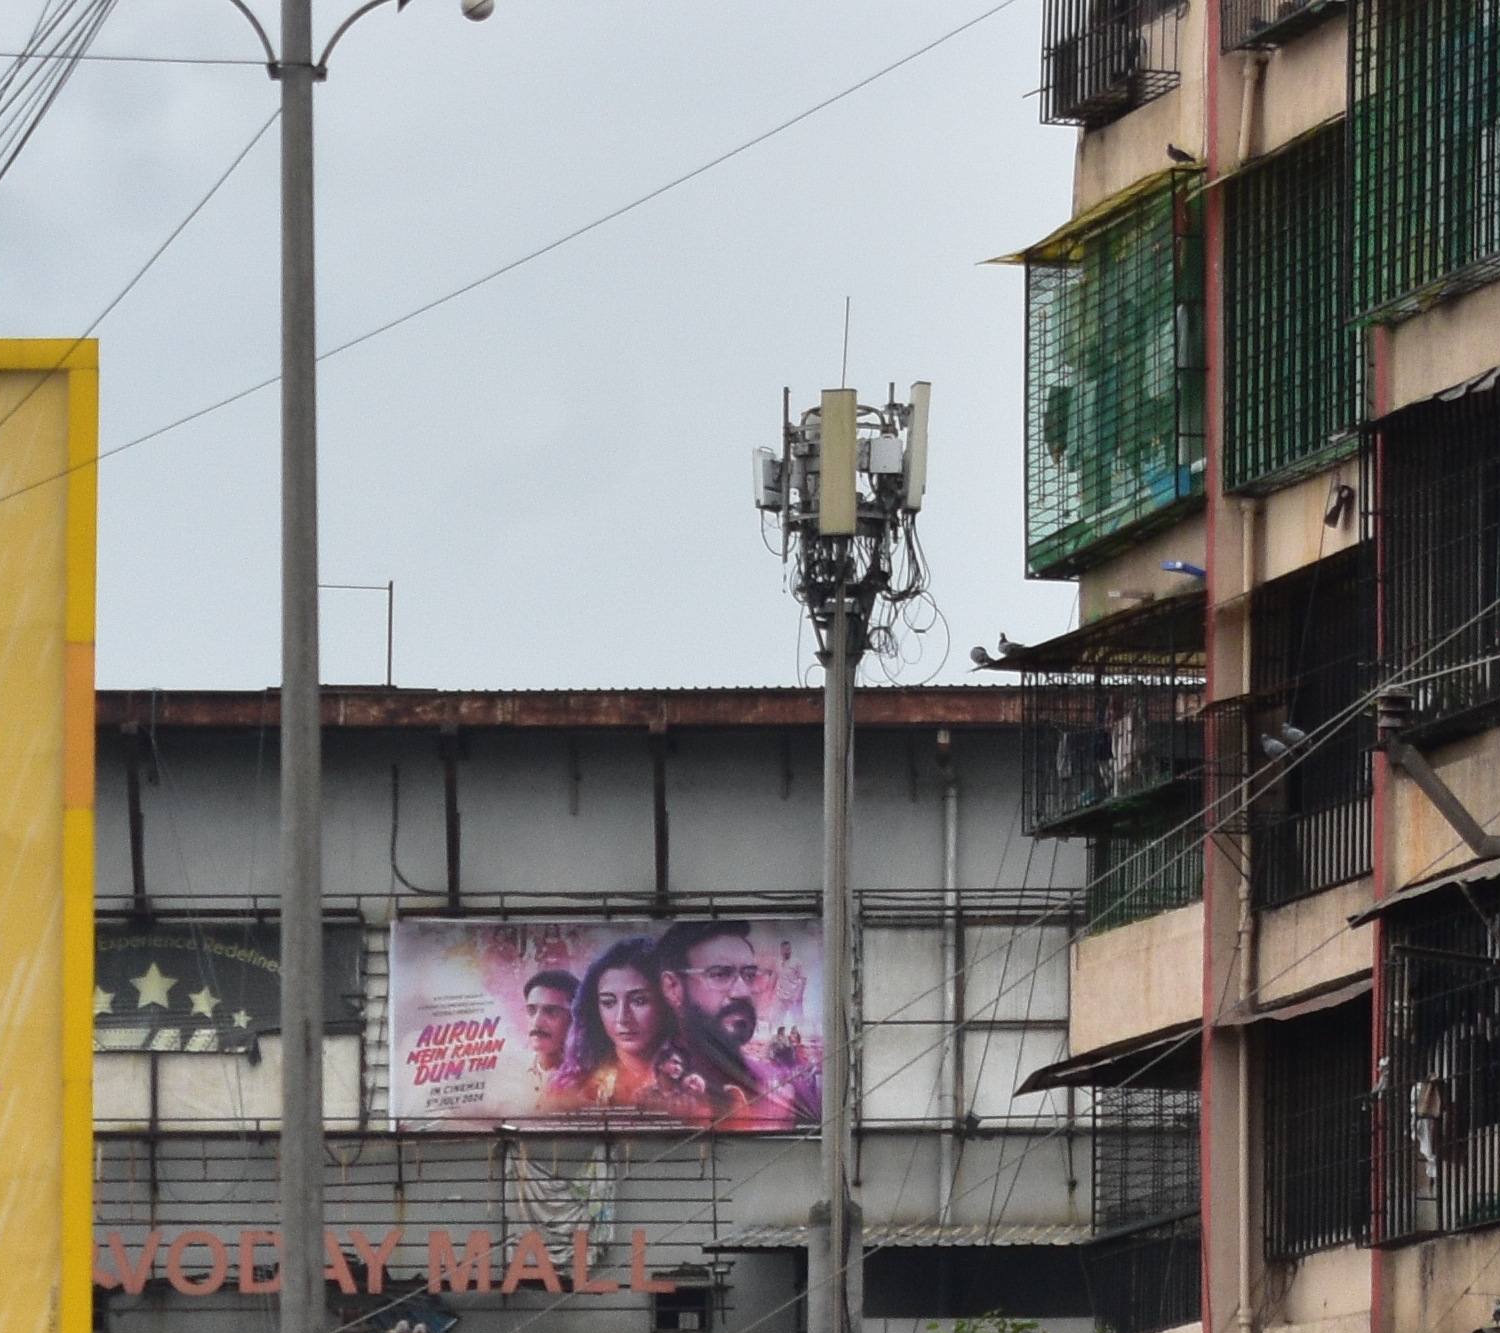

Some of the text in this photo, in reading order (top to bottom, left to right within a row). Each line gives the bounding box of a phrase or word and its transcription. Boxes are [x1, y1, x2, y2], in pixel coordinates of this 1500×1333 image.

[417, 1016, 501, 1048] AURON
[406, 1038, 506, 1065] MEIN KAHAN
[414, 1055, 498, 1086] DUM THA
[428, 1229, 677, 1294] MALL
